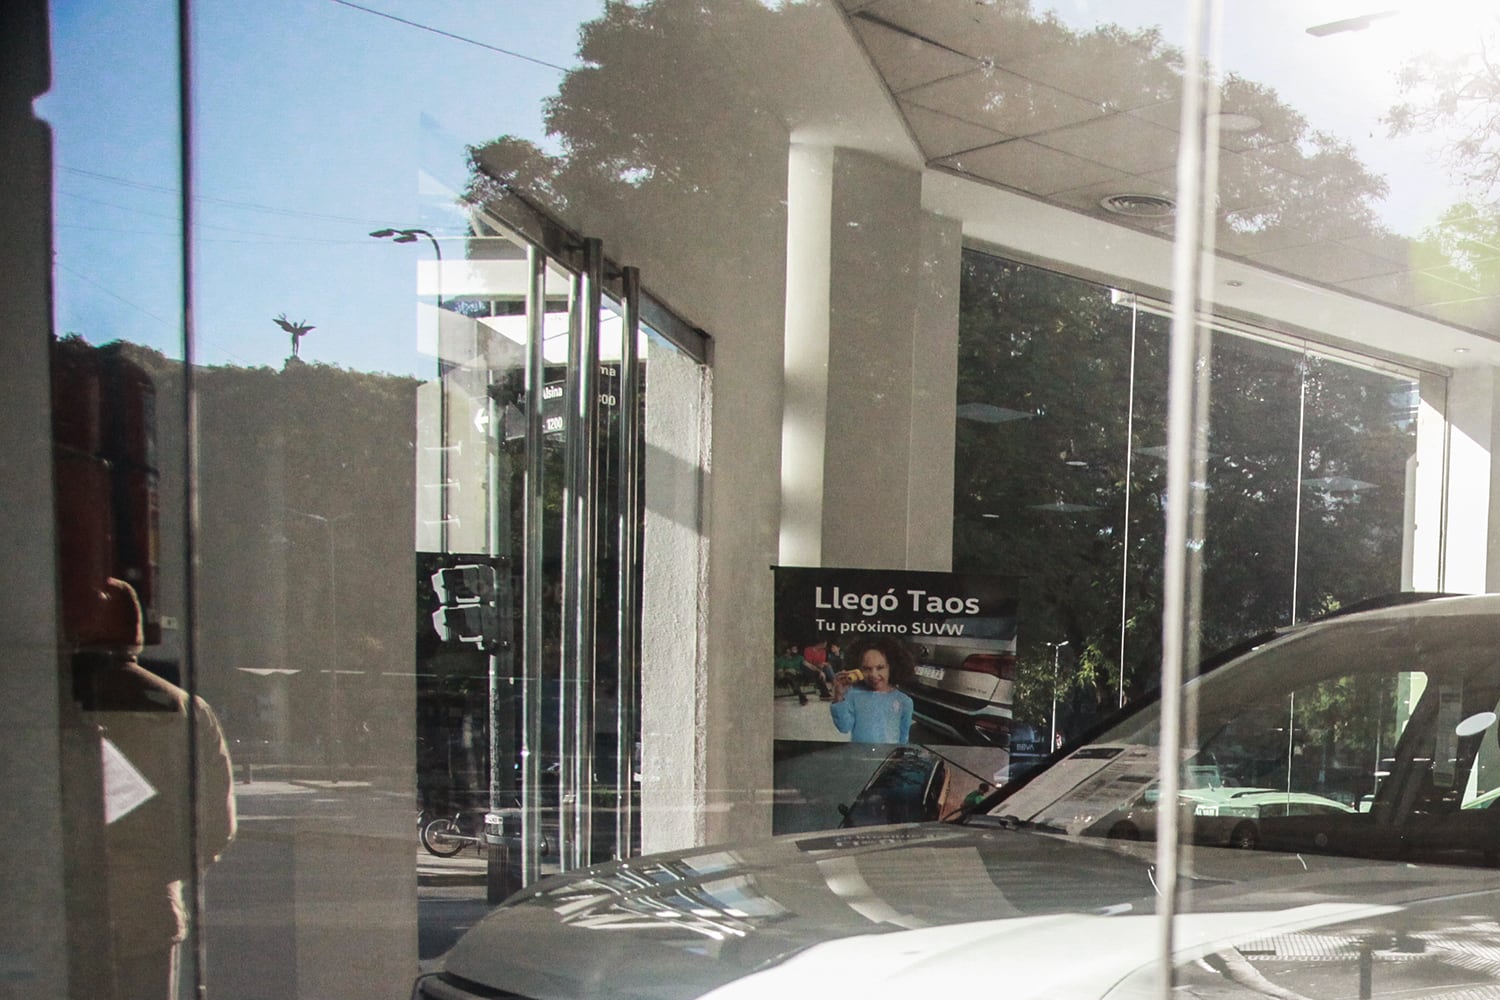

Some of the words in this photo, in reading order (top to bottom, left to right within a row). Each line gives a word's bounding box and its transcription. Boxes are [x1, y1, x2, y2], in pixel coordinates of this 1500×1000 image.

[815, 586, 899, 616] Llegó
[907, 589, 980, 615] Taos
[816, 619, 836, 632] Tu
[840, 620, 908, 635] próximo
[911, 622, 964, 636] SUVW
